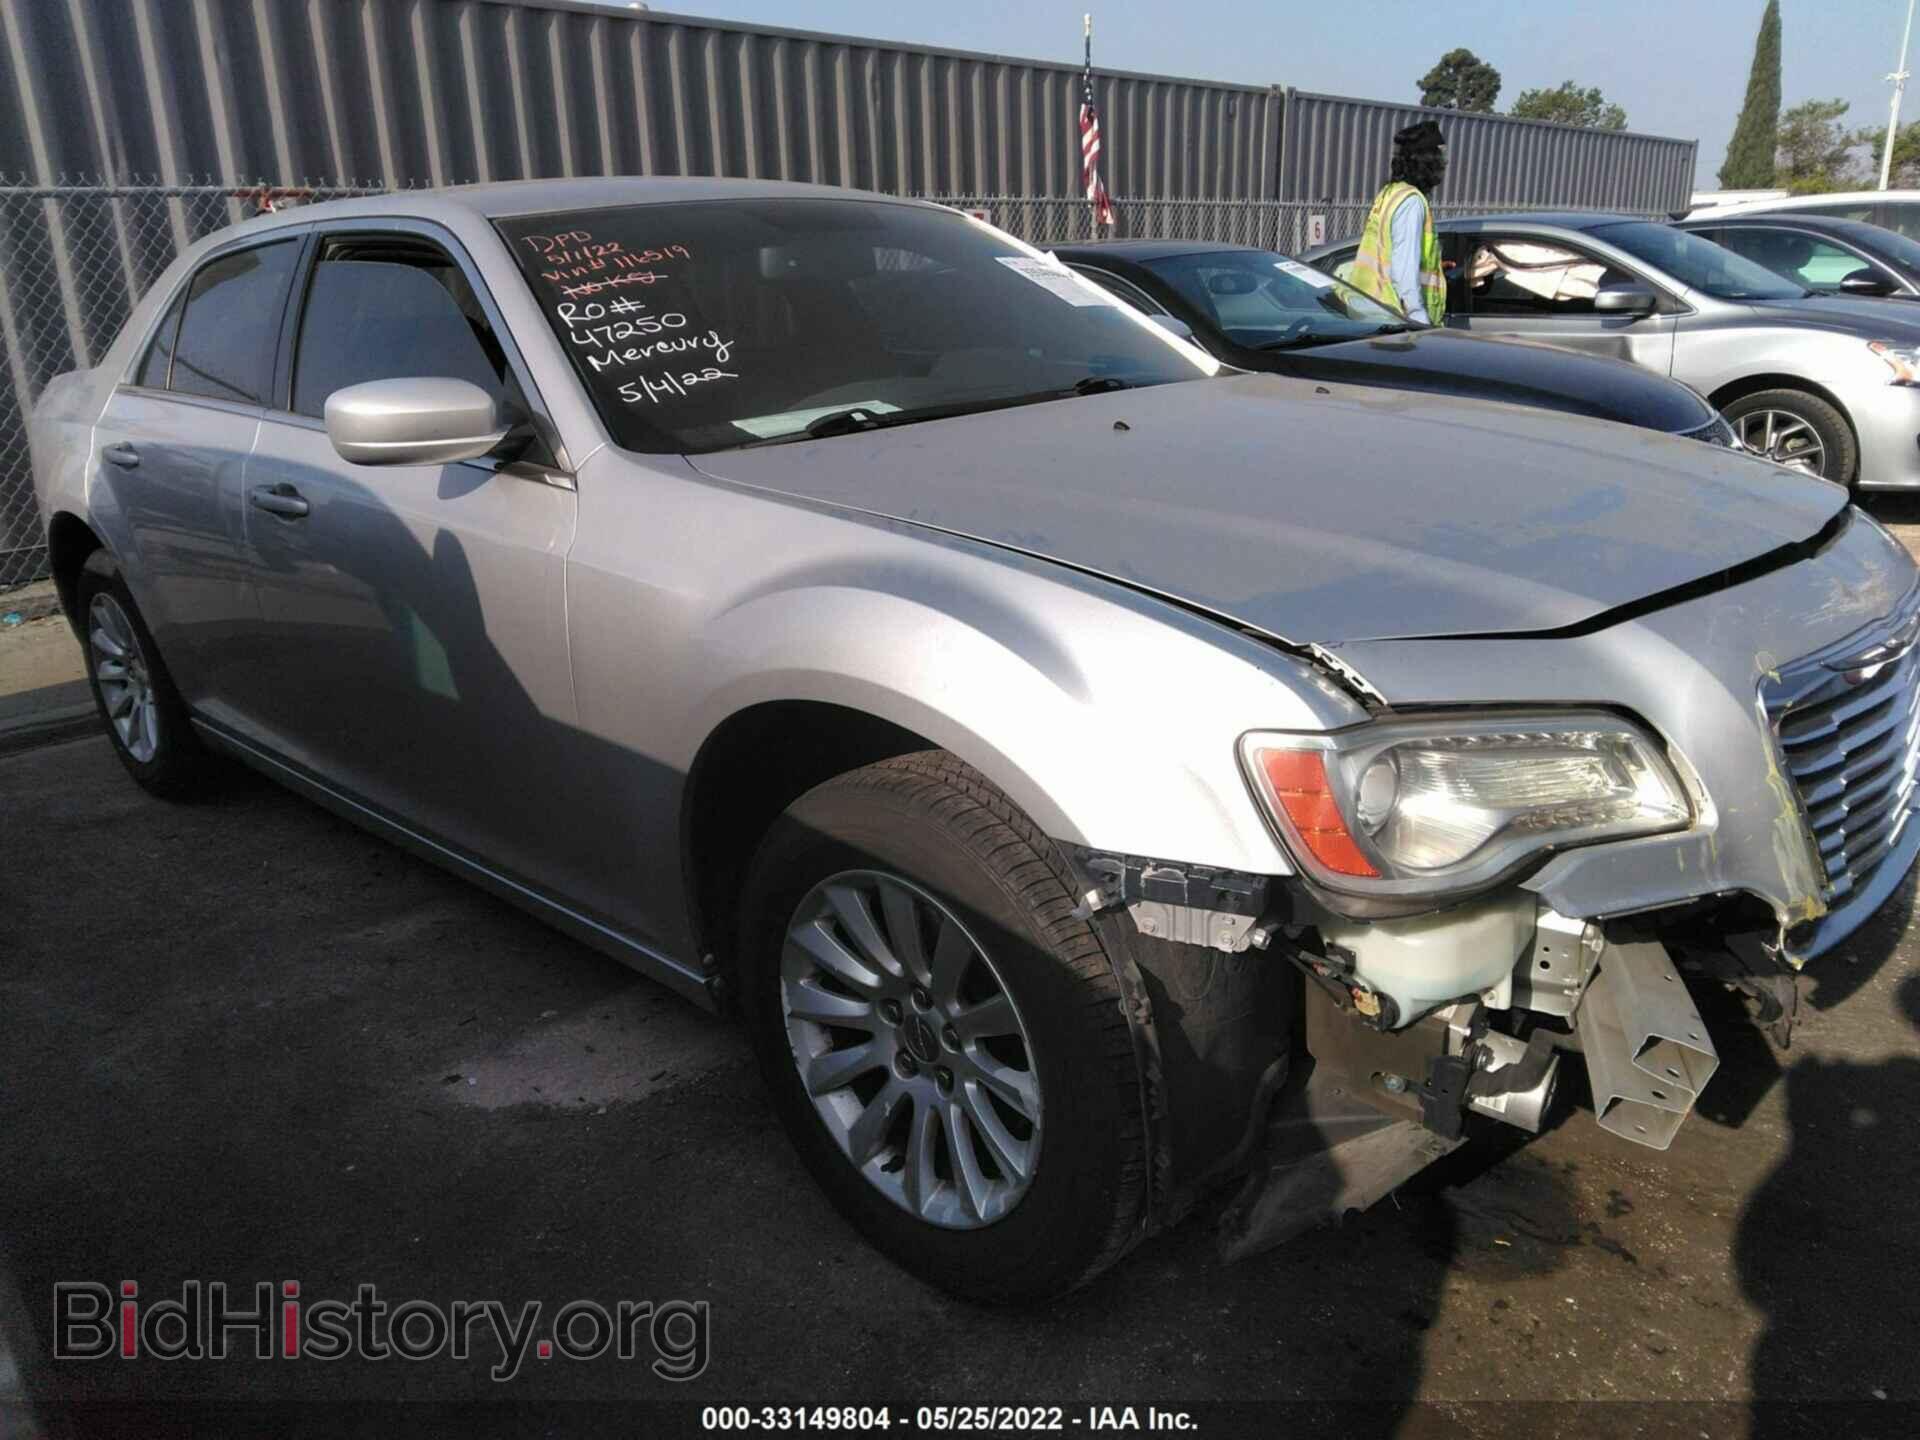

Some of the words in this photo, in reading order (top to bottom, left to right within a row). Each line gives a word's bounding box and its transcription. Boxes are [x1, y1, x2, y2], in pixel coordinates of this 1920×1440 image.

[521, 231, 592, 252] DPD
[1315, 221, 1321, 240] 6
[557, 296, 646, 328] RO#
[571, 313, 686, 348] 47250
[586, 330, 735, 373] Mercury
[617, 368, 738, 404] 5/4/22
